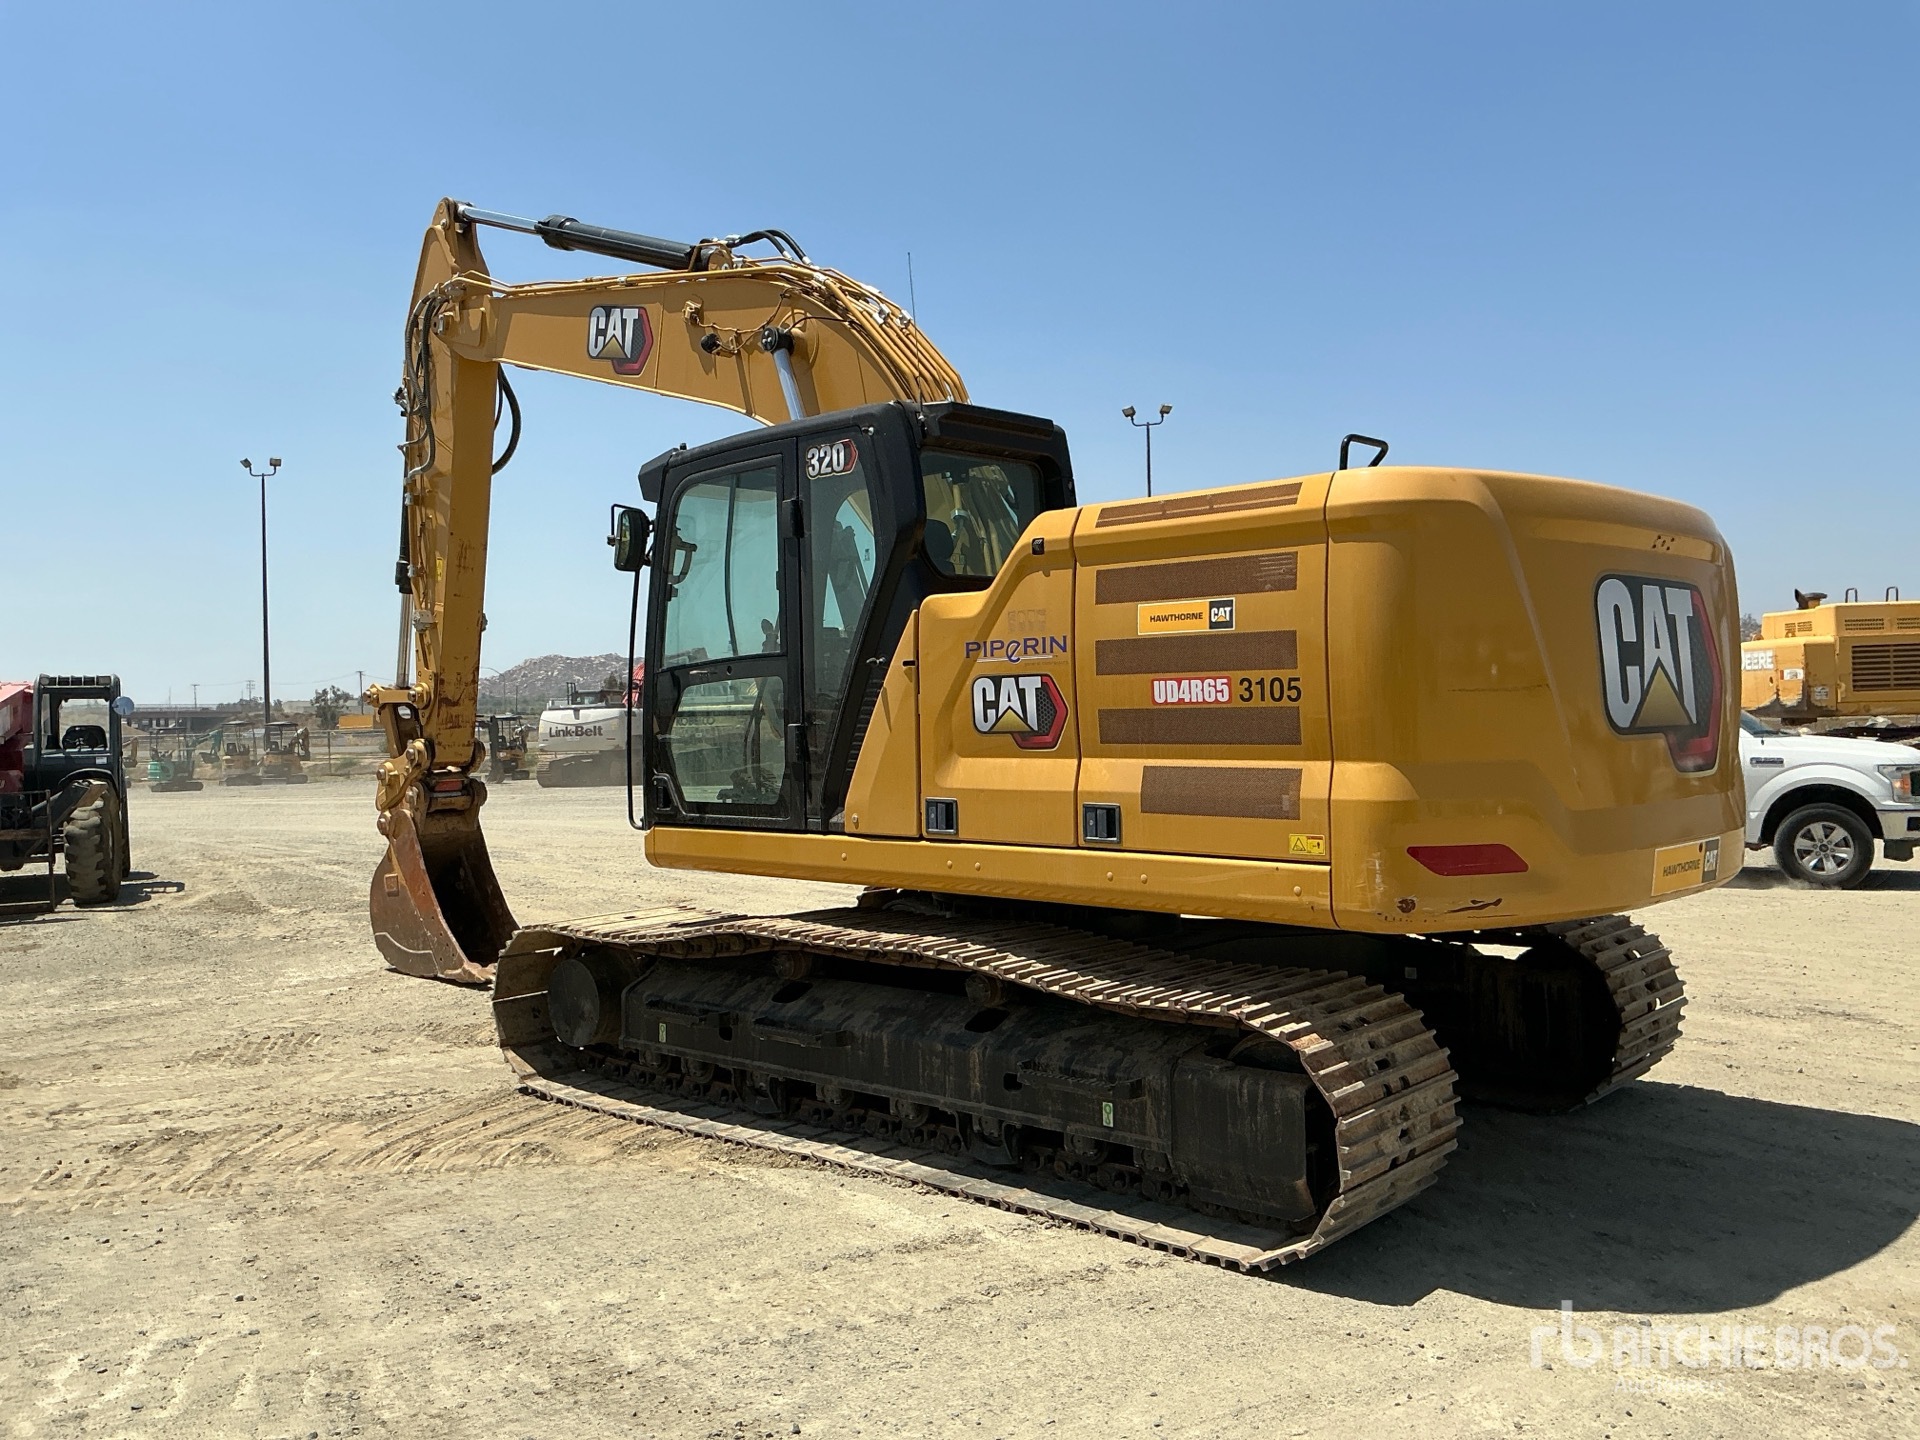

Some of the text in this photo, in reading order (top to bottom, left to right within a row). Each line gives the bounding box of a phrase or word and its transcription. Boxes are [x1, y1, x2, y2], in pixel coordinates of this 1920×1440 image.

[589, 307, 639, 358] CAT
[807, 443, 845, 477] 320
[1149, 606, 1233, 623] HAWTHORNE CAT
[1597, 577, 1698, 729] CAT
[973, 675, 1042, 732] CAT
[1153, 677, 1302, 704] UD4R65 3105
[1662, 849, 1718, 877] HAWTHORNE CAT
